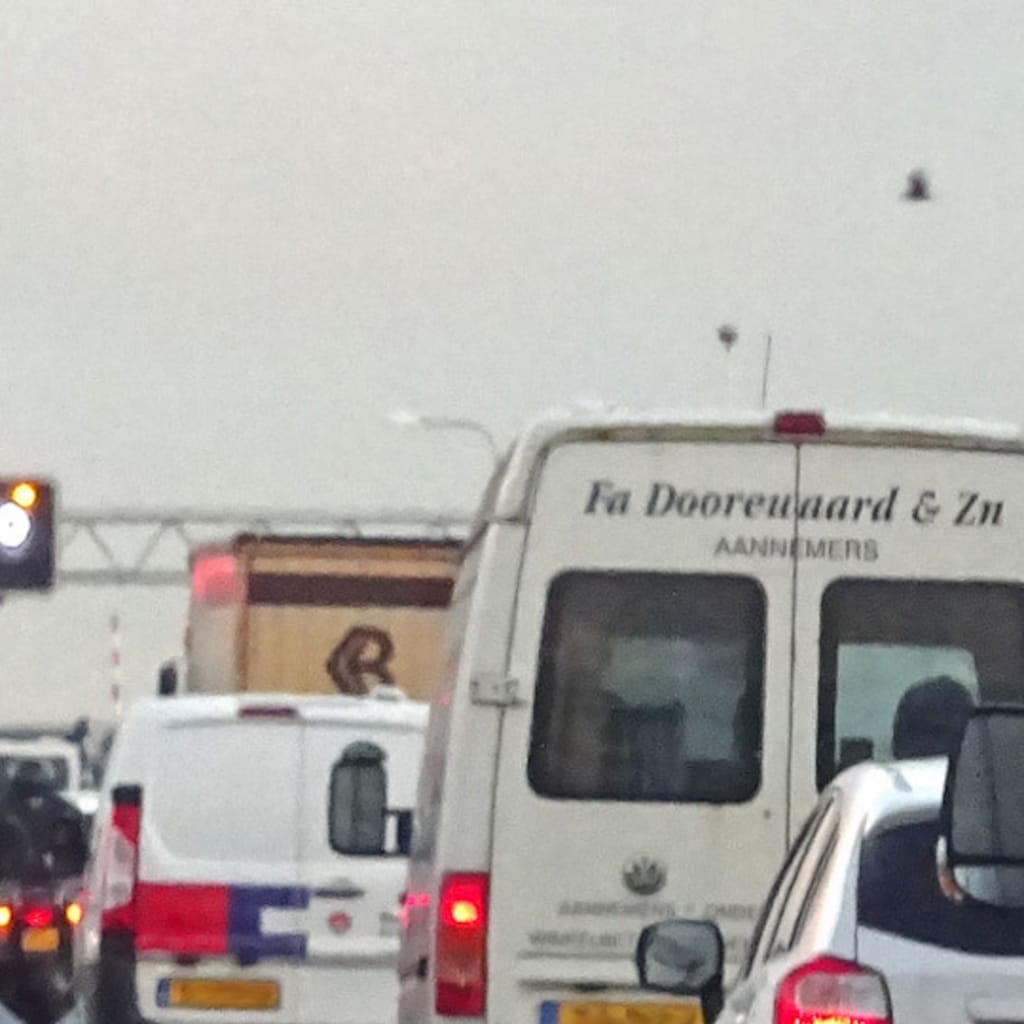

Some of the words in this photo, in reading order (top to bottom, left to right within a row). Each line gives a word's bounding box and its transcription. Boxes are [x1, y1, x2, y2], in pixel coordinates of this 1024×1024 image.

[584, 481, 631, 516] Fa
[912, 491, 939, 525] &
[955, 491, 1004, 526] Zn
[714, 537, 879, 561] AANNEMERS
